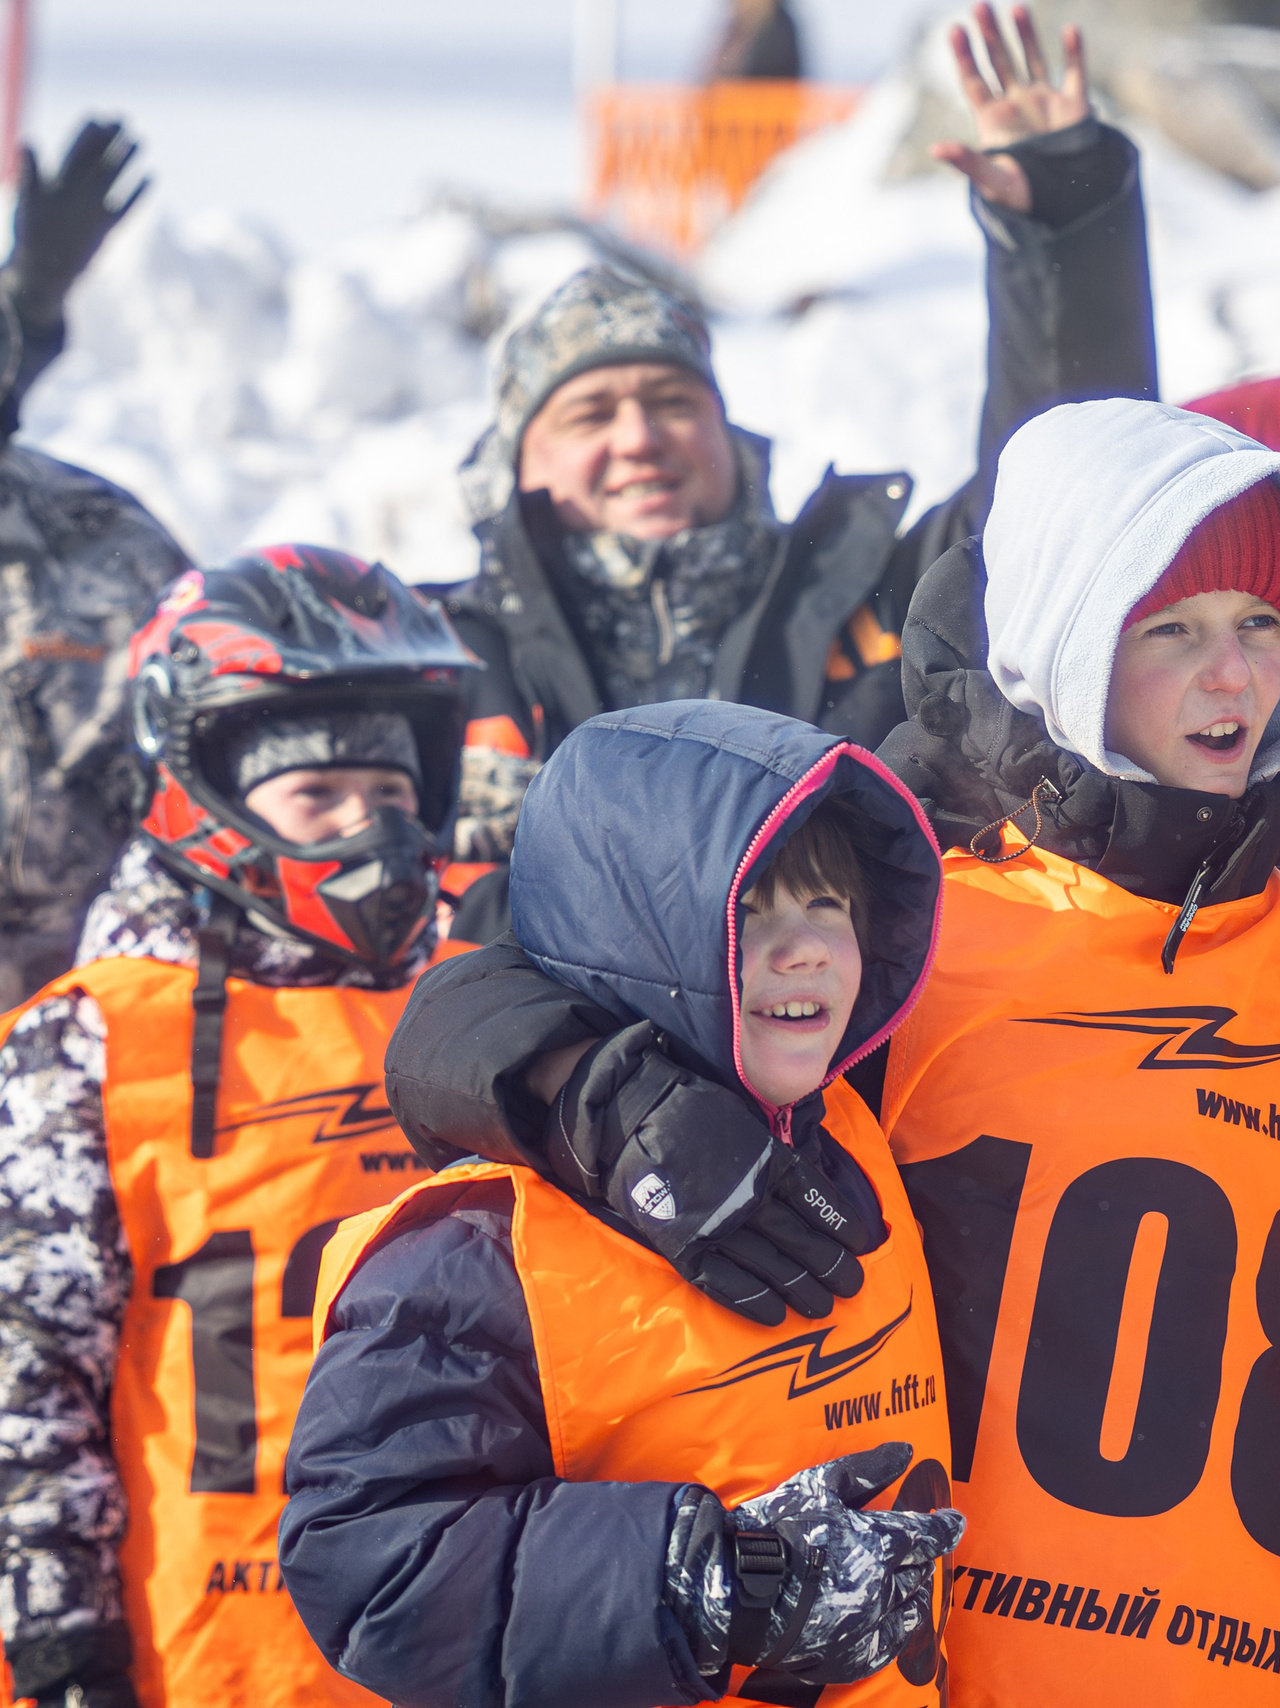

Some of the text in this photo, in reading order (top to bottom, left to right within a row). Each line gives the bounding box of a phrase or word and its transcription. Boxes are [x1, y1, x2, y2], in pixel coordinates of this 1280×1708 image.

[804, 1188, 847, 1230] SPORT
[152, 1218, 341, 1495] 1
[824, 1374, 936, 1431] www.hft.ru
